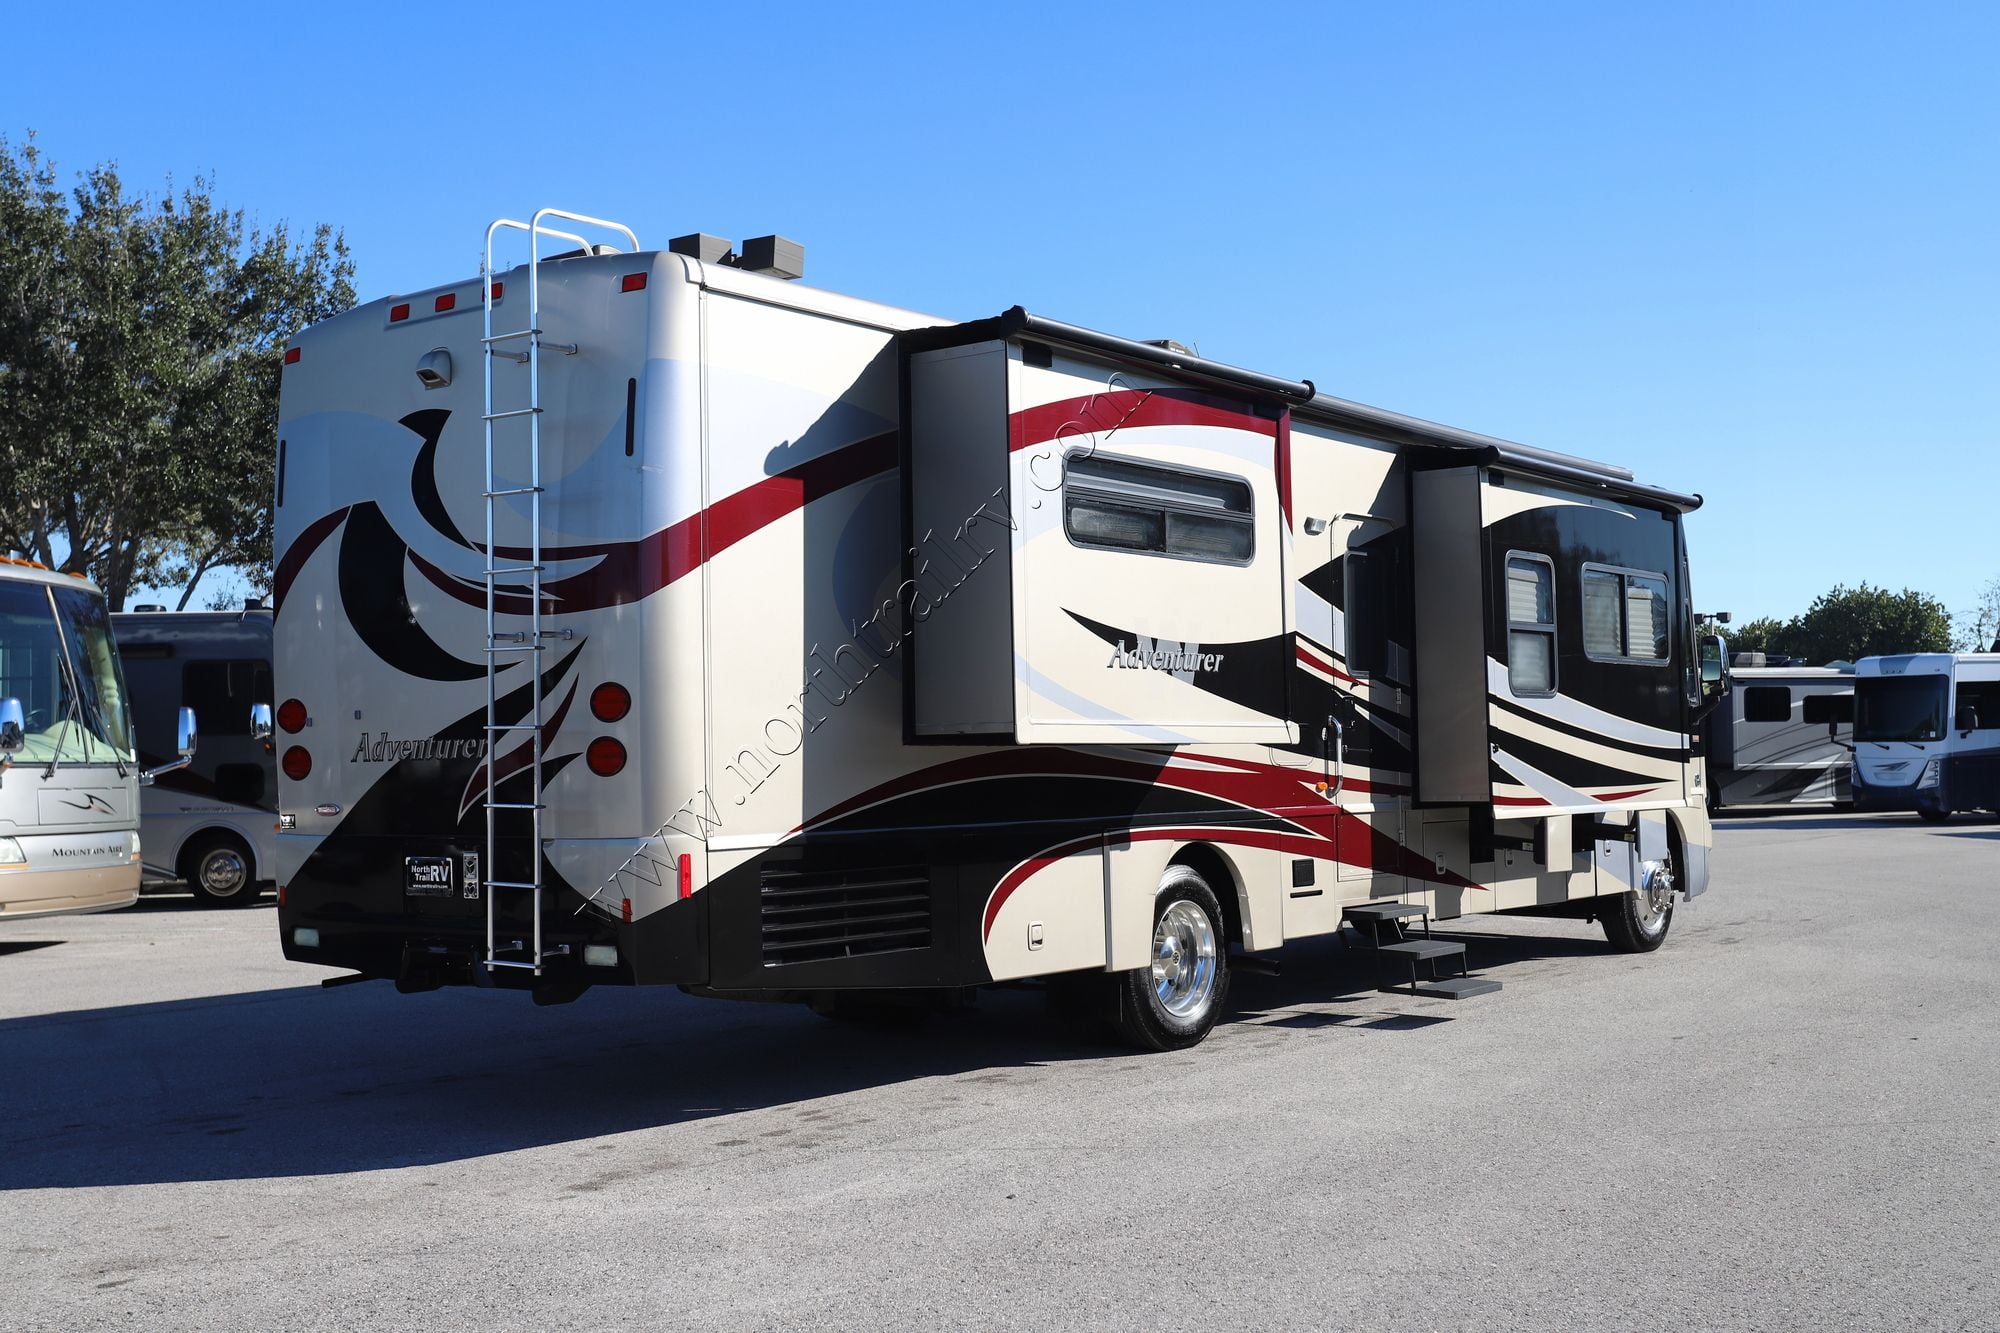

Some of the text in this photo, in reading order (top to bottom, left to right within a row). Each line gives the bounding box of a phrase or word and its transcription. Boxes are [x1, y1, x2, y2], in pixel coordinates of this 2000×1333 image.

[1106, 639, 1224, 672] Adventurer
[350, 732, 488, 763] Adventurer
[411, 865, 430, 873] North
[415, 873, 430, 881] Trail
[430, 865, 449, 881] RV
